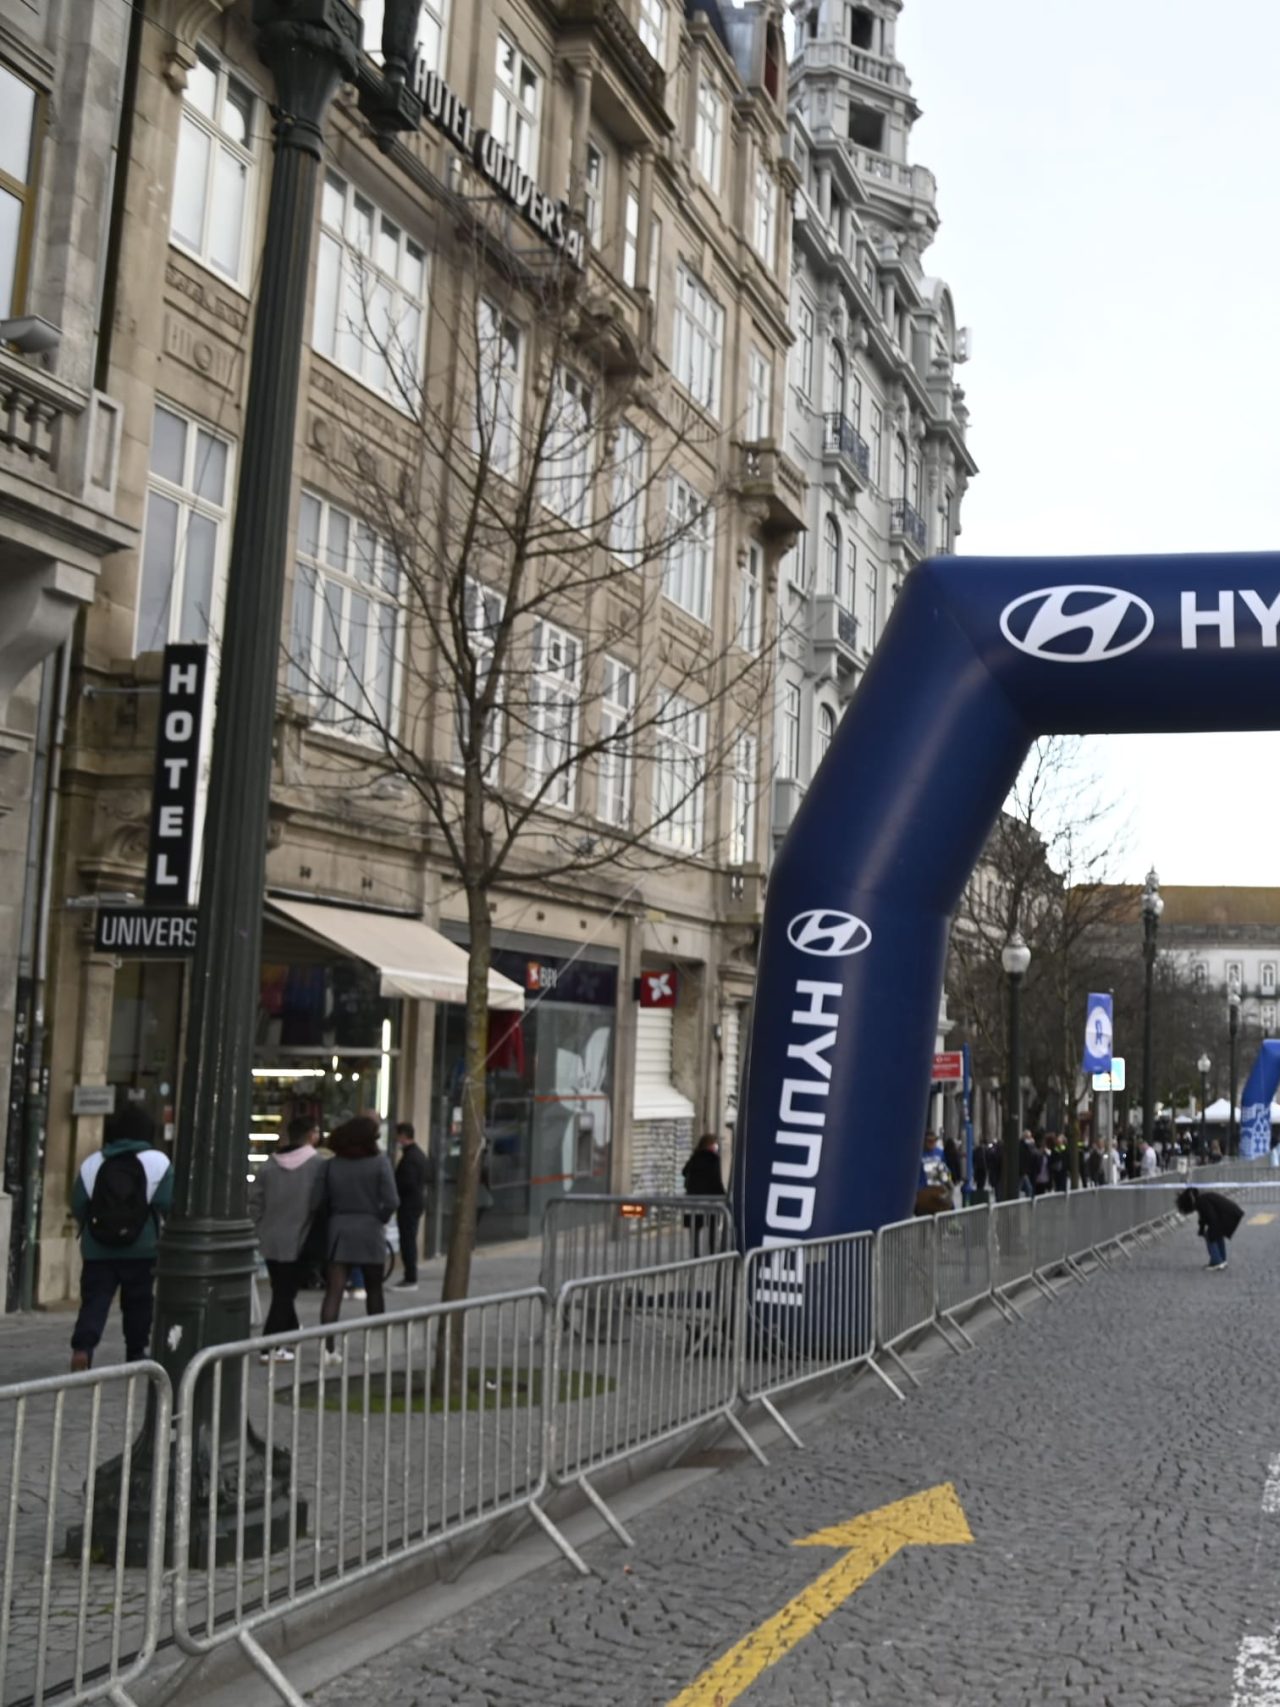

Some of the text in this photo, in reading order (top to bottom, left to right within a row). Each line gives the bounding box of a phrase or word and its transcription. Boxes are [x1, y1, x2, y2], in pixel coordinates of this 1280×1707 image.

[414, 58, 585, 269] HOTEL UNIVERSAL
[156, 663, 198, 885] HOTEL
